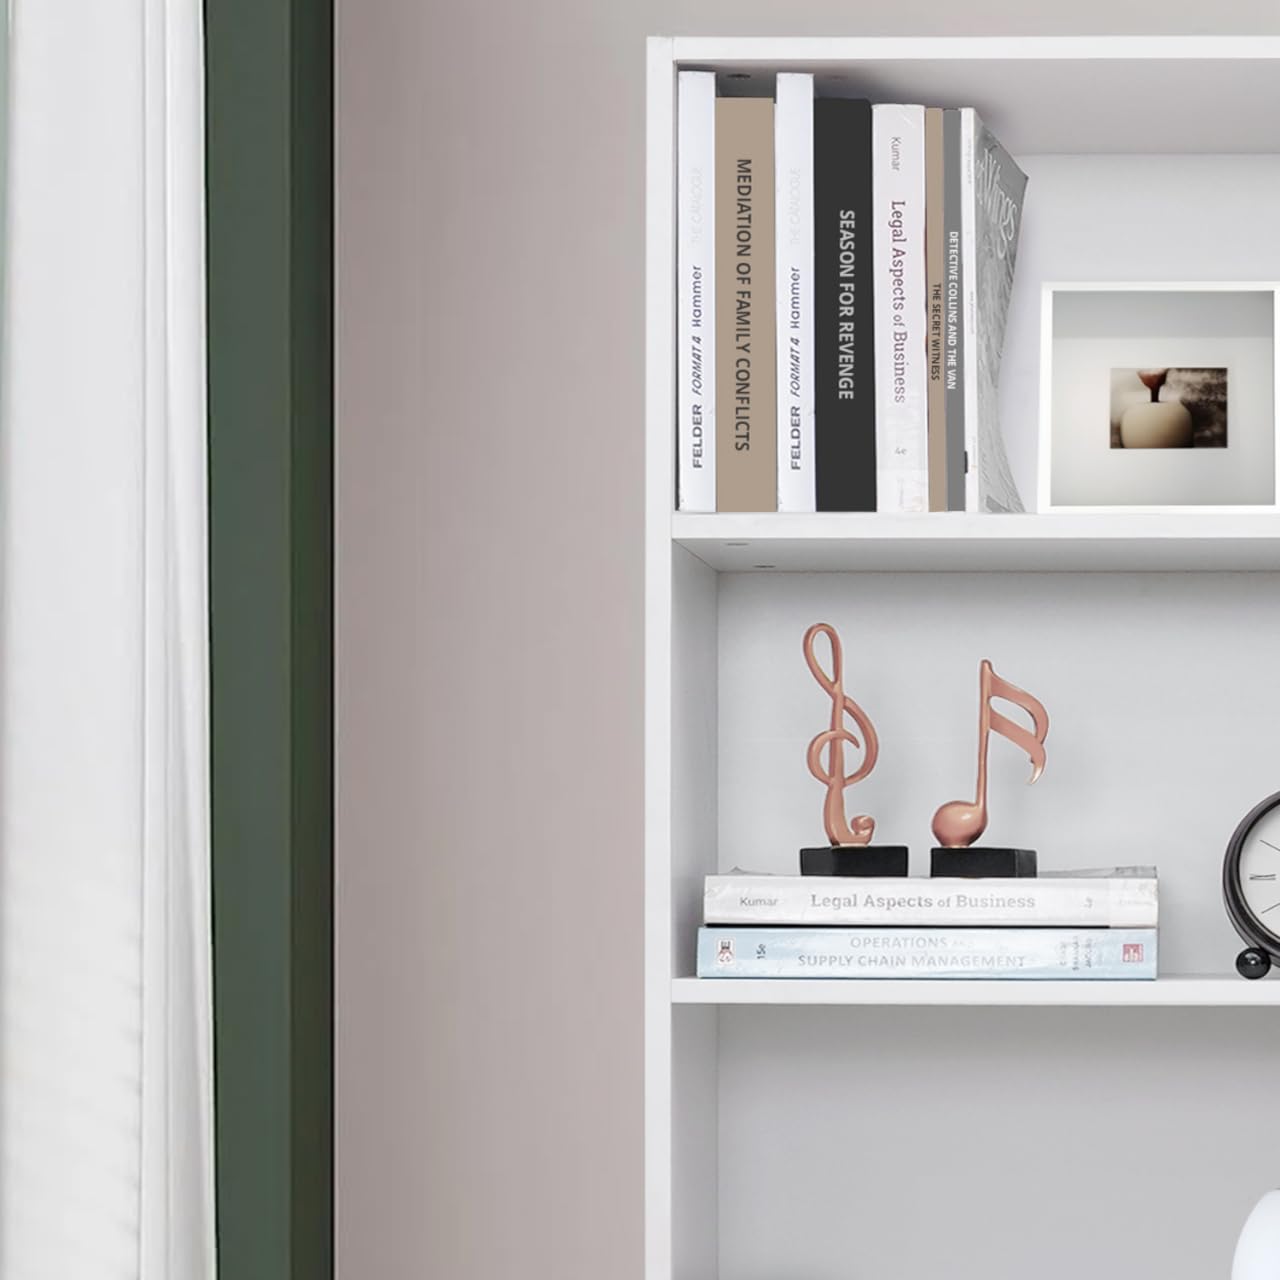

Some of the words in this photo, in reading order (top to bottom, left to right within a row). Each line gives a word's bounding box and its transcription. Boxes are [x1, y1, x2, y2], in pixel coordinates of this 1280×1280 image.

[890, 136, 902, 171] Kumar
[736, 159, 752, 257] MEDIATION
[887, 201, 908, 243] Legal
[839, 209, 856, 278] SEASON
[948, 231, 959, 281] DETECTIVE
[735, 262, 751, 285] OF
[888, 247, 907, 311] Aspects
[838, 283, 855, 317] FOR
[932, 283, 942, 301] THE
[735, 290, 752, 354] FAMILY
[892, 314, 906, 327] of
[931, 303, 941, 337] SECRET
[947, 324, 957, 346] AND
[838, 321, 855, 400] REVENGE
[893, 331, 909, 403] Business
[947, 348, 957, 367] THE
[947, 369, 957, 390] VAN
[734, 357, 751, 451] CONFLICTS
[739, 896, 778, 907] Kumar
[811, 894, 858, 910] Legal
[863, 894, 933, 910] Aspects
[937, 896, 951, 908] of
[955, 894, 1036, 909] Business
[850, 936, 947, 949] OPERATIONS
[798, 954, 852, 967] SUPPLY
[858, 954, 906, 967] CHAIN
[911, 954, 1026, 967] MANAGEMENT
